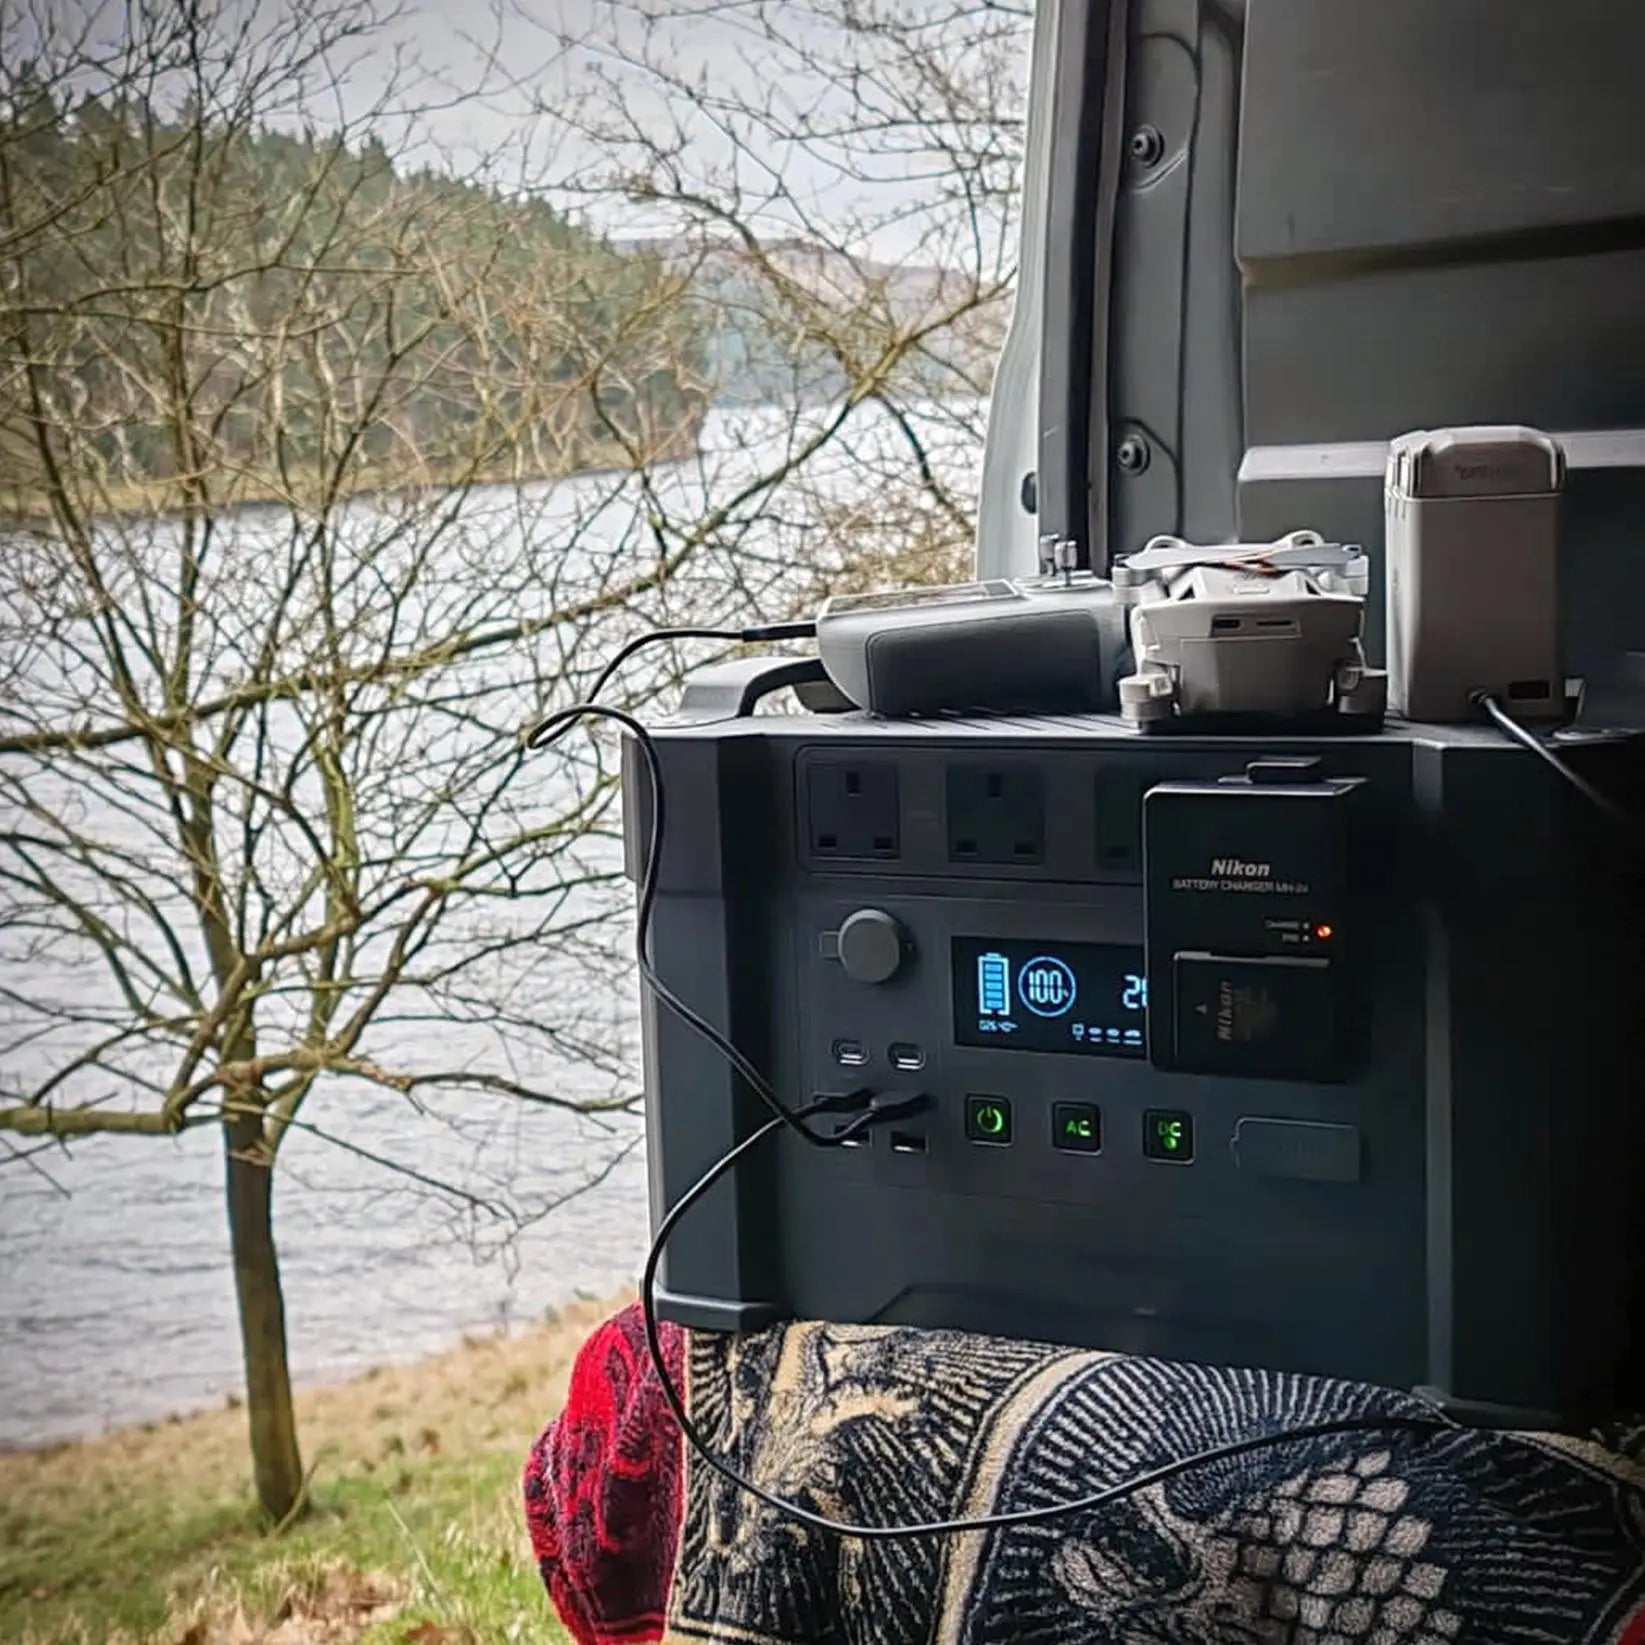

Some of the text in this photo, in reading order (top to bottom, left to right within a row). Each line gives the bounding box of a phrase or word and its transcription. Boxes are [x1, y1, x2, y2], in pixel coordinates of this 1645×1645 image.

[1211, 859, 1271, 877] Nikon
[1216, 981, 1233, 1040] Nikon
[1065, 1120, 1092, 1137] AC
